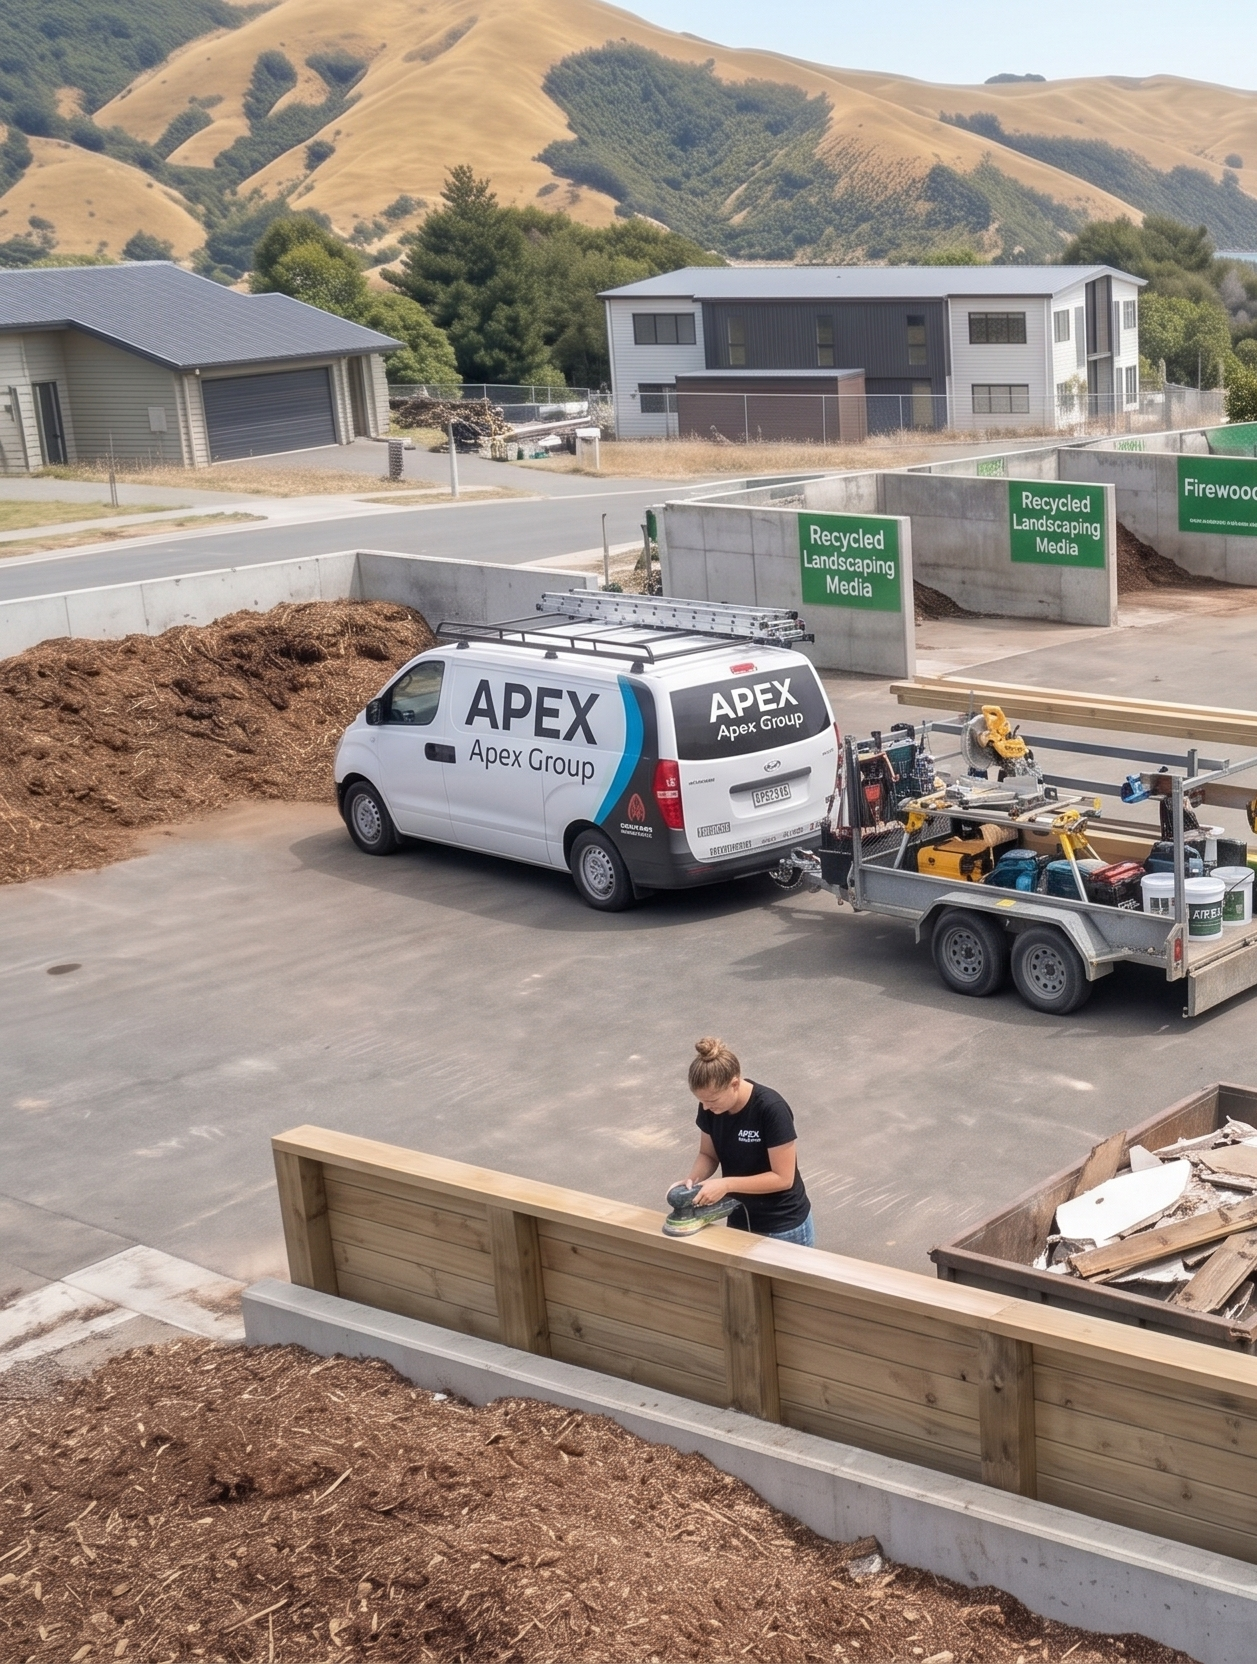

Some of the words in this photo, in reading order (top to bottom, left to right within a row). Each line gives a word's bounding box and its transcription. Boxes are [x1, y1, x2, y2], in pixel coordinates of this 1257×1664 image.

[1022, 491, 1091, 515] Recycled
[809, 524, 885, 553] Recycled
[1012, 512, 1101, 541] Landscaping
[1036, 536, 1079, 556] Media
[803, 549, 895, 580] Landscaping
[826, 574, 873, 598] Media
[464, 678, 601, 746] APEX
[709, 677, 799, 724] APEX
[717, 721, 757, 742] Apex
[760, 712, 804, 730] Group
[469, 738, 523, 770] Apex
[528, 747, 596, 786] Group
